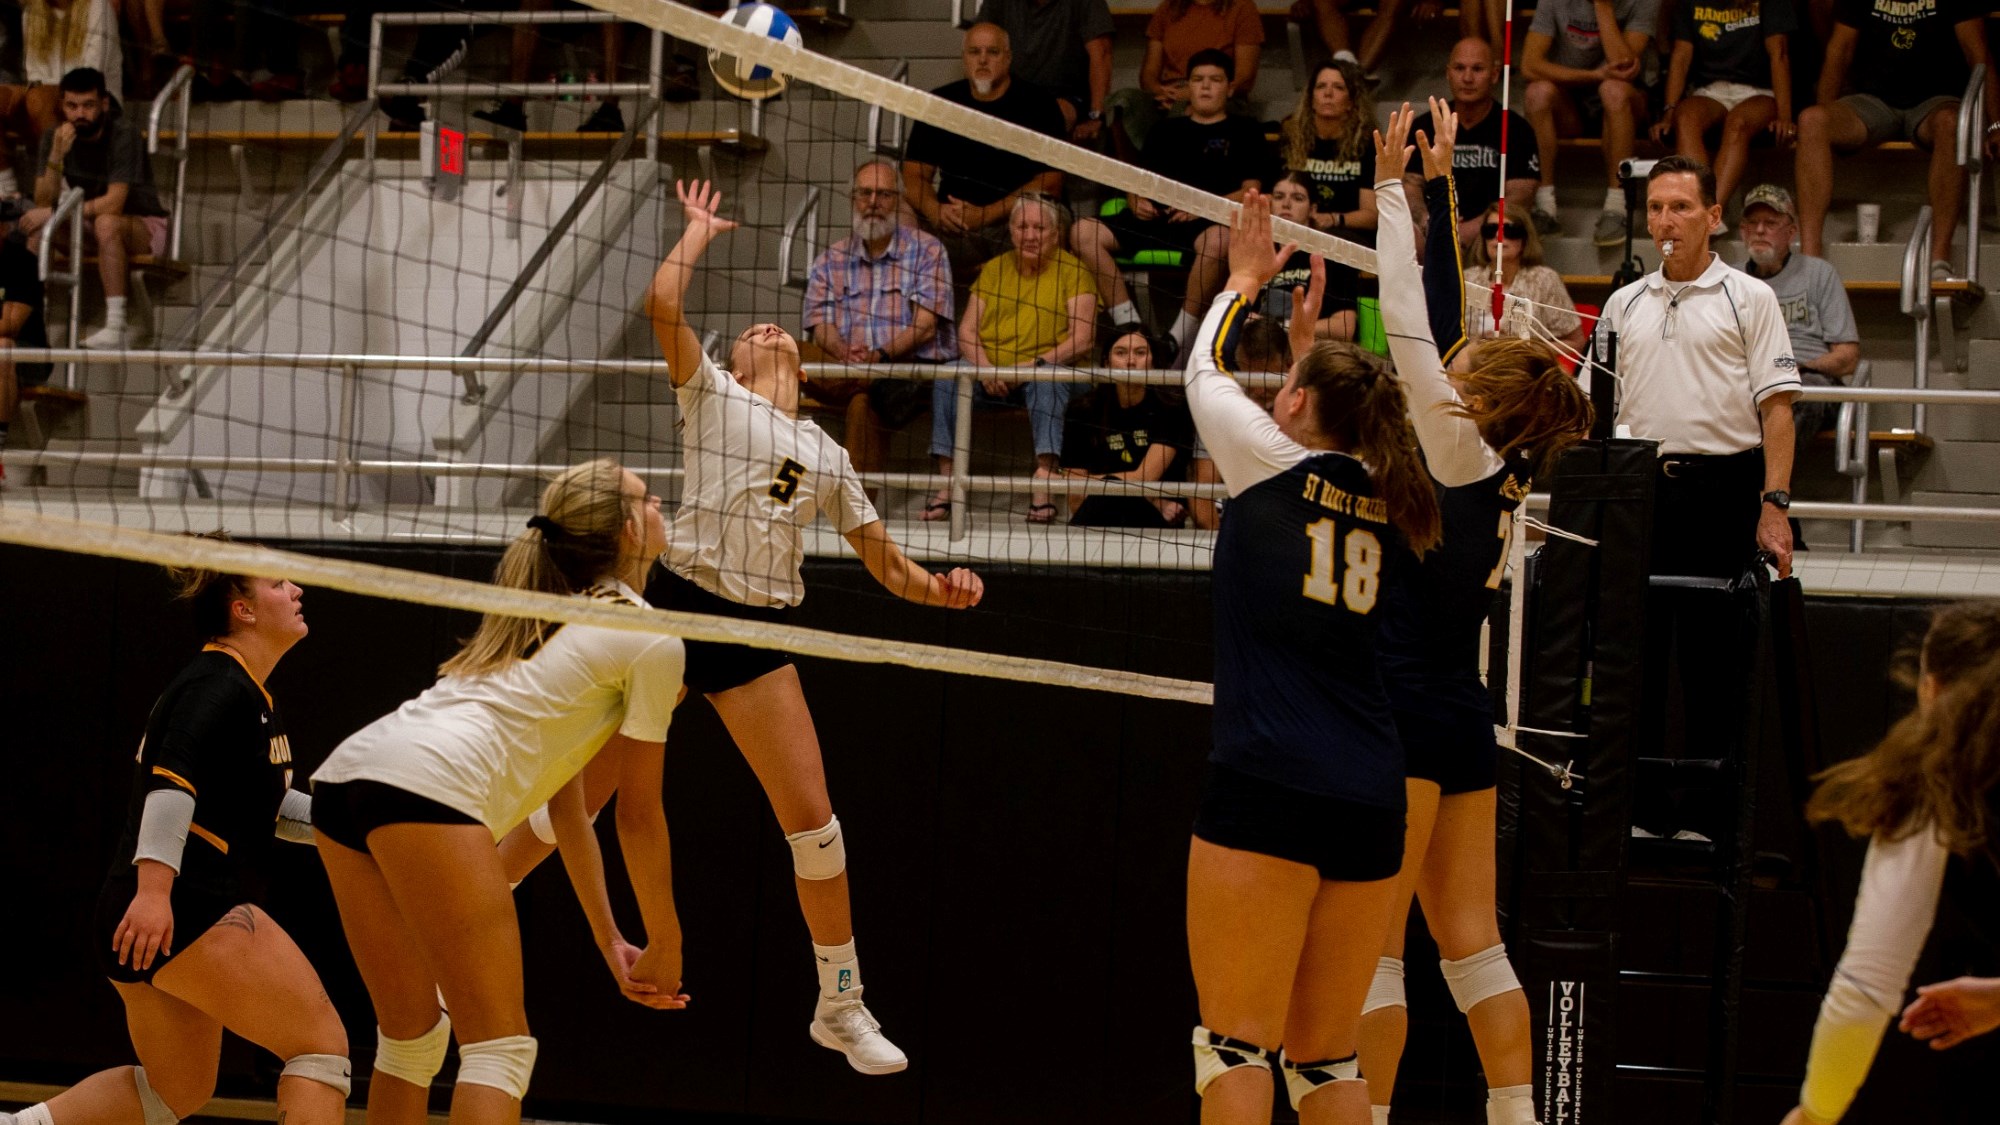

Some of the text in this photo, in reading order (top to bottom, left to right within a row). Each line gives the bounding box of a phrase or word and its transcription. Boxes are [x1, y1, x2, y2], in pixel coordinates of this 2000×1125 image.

[1874, 0, 1936, 16] RANDOPH
[440, 127, 465, 175] EXIT
[1305, 158, 1361, 176] NDOLPH
[768, 455, 807, 506] 5
[1302, 516, 1382, 615] 18
[1576, 1028, 1585, 1064] UNITED
[1543, 1027, 1554, 1124] UNITED VOLLEYBALL
